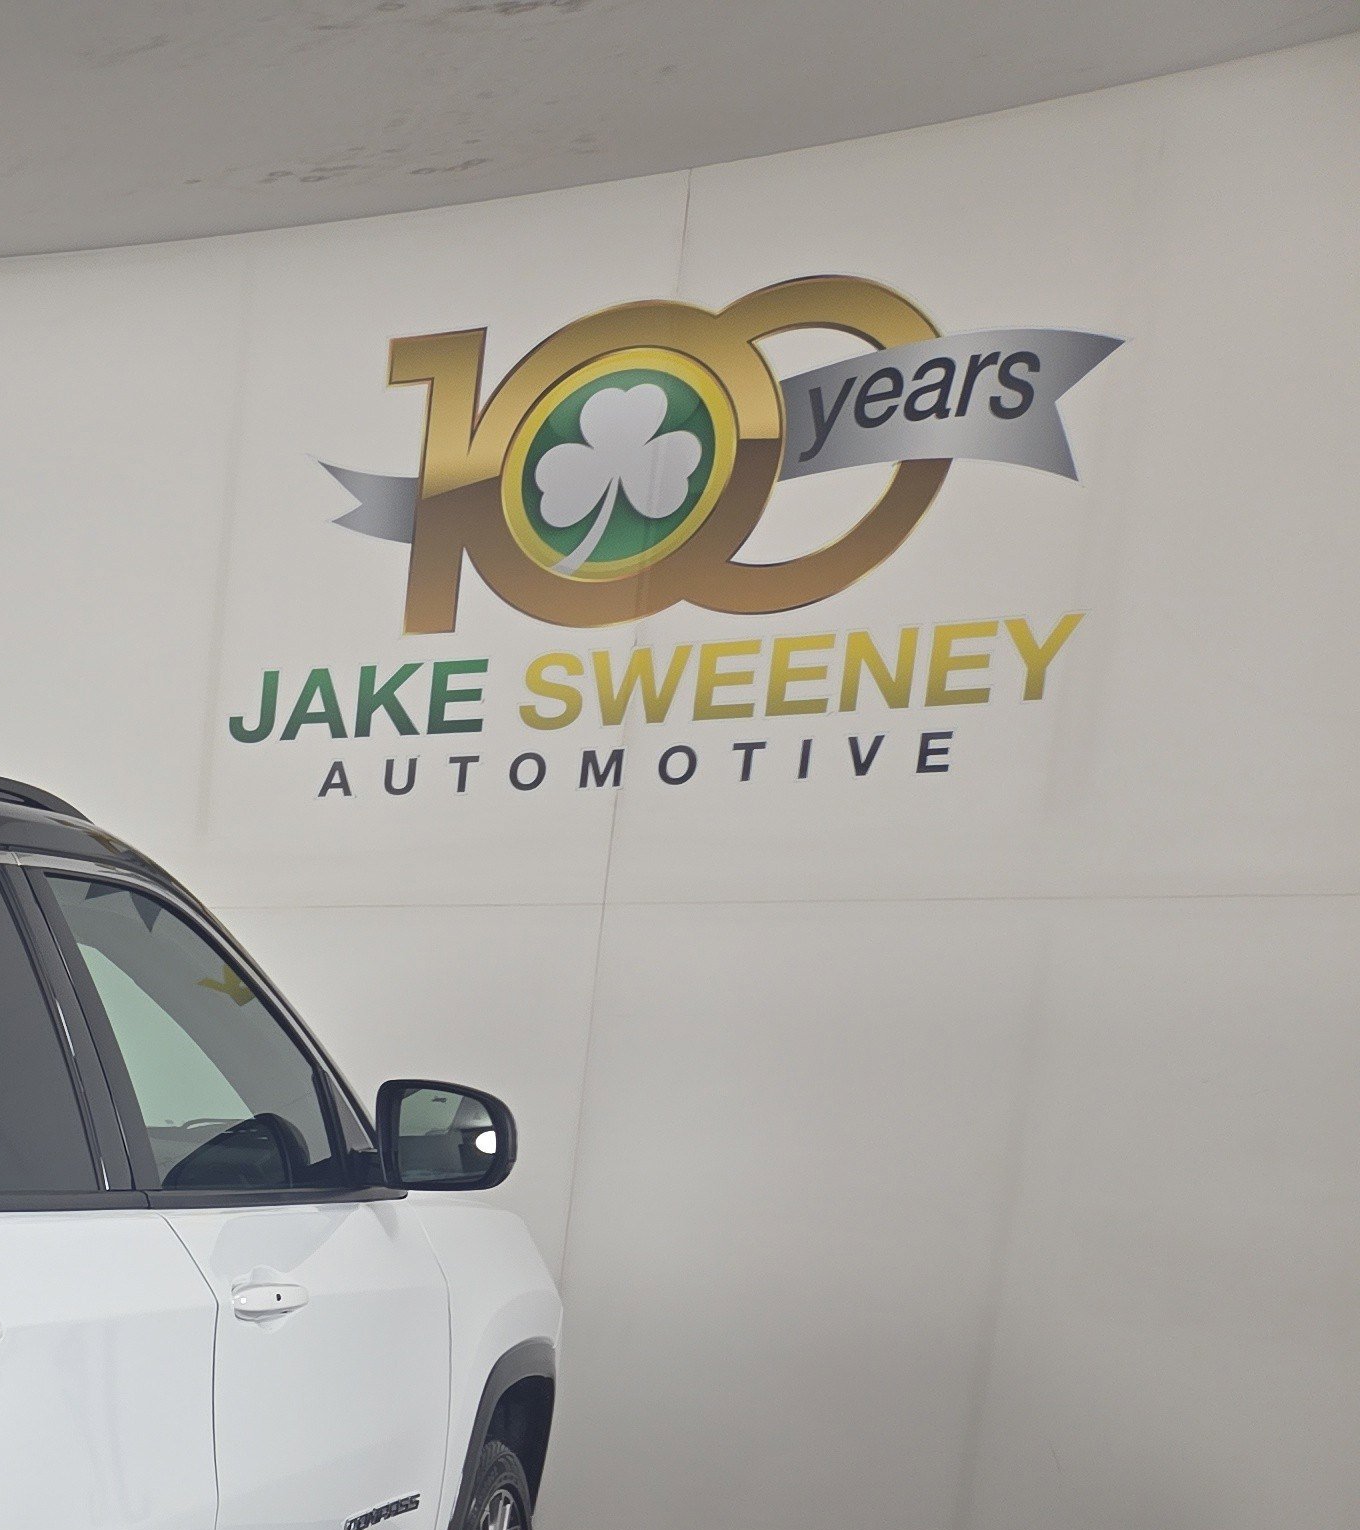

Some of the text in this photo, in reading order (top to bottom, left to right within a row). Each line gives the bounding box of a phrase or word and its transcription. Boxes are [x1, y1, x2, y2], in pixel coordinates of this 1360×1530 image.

[388, 274, 954, 635] 100
[799, 350, 1042, 463] years
[228, 613, 1083, 744] JAKE SWEENEY
[318, 731, 956, 798] AUTOMOTIVE
